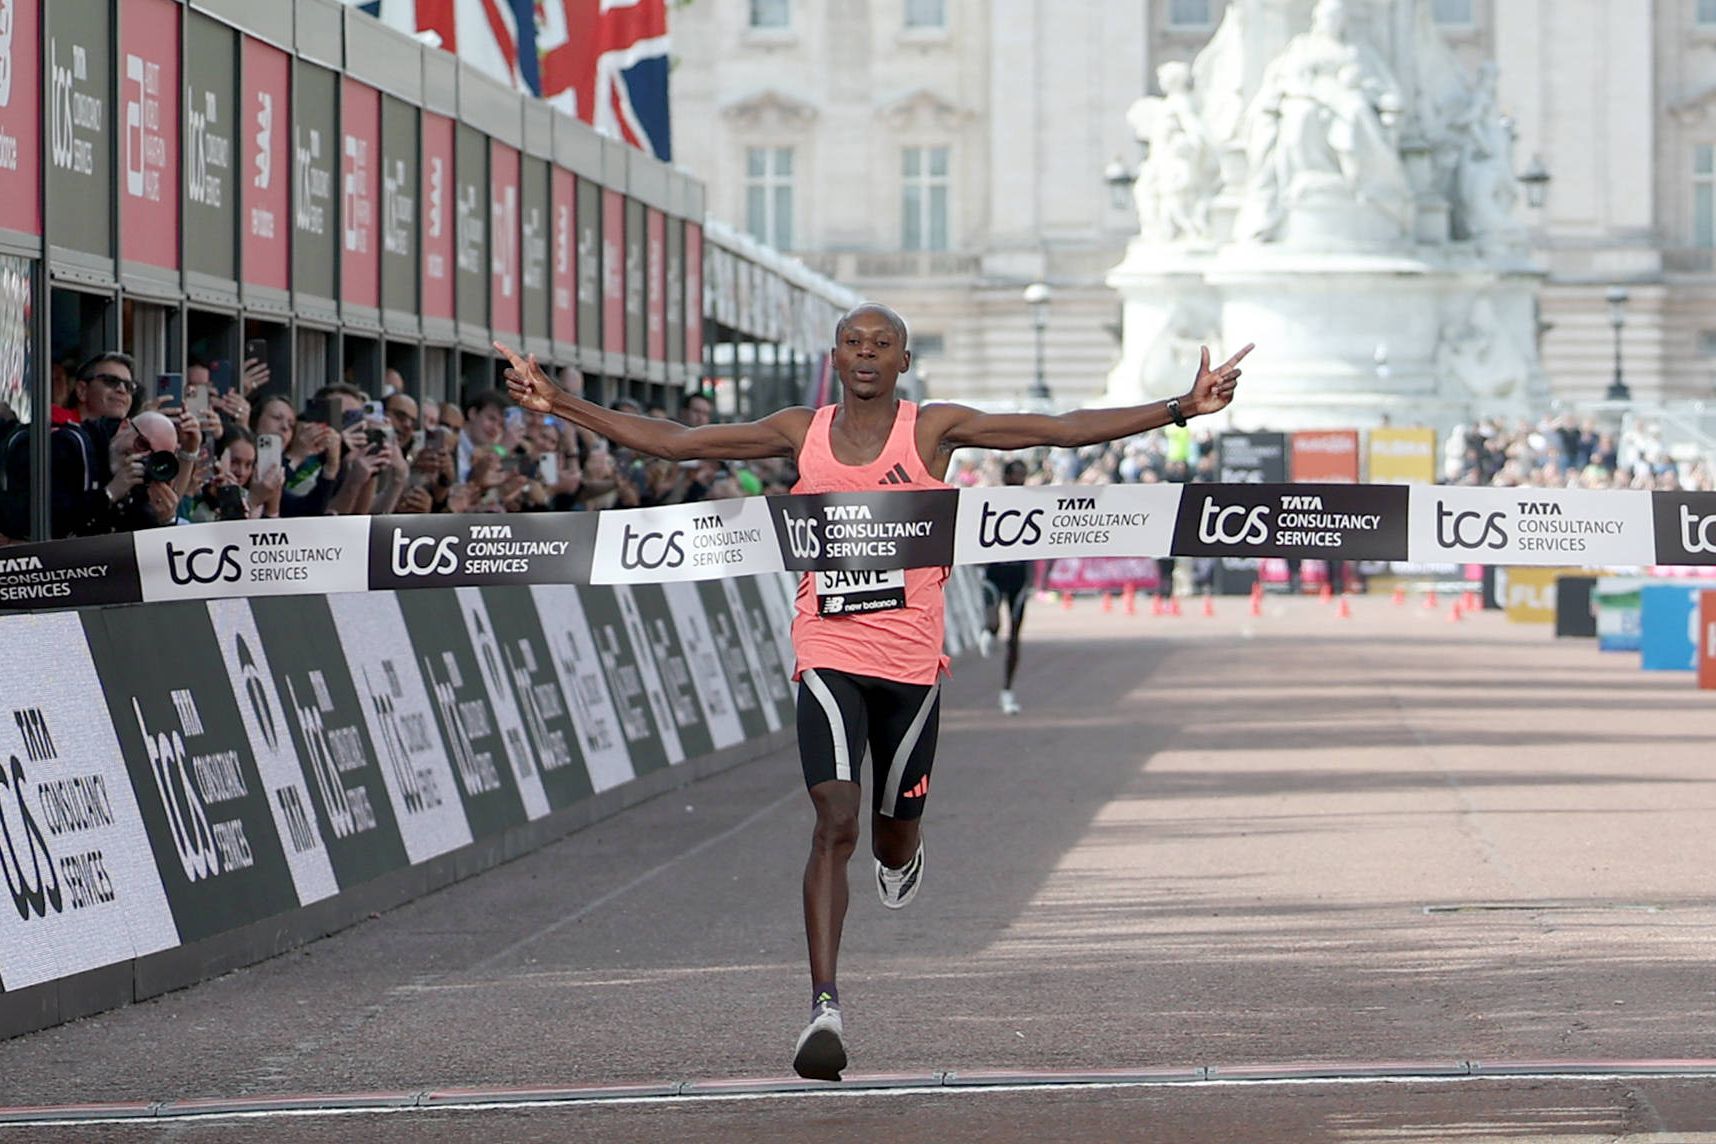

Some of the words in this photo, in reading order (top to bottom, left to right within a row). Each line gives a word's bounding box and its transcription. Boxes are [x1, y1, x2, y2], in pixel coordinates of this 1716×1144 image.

[1056, 498, 1096, 510] TATA
[1280, 496, 1323, 510] TATA
[1517, 503, 1562, 515] TATA
[824, 505, 872, 520] TATA
[1051, 513, 1150, 528] CONSULTANCY
[1198, 496, 1270, 545] tcs
[693, 515, 723, 530] TATA
[825, 521, 933, 539] CONSULTANCY
[979, 501, 1044, 548] tcs
[1277, 513, 1380, 531] CONSULTANCY
[1436, 500, 1508, 550] tcs
[1517, 519, 1624, 535] CONSULTANCY
[249, 533, 288, 546] TATA
[469, 525, 512, 539] TATA
[693, 528, 762, 549] CONSULTANCY
[782, 508, 820, 558] tcs
[1048, 530, 1109, 545] SERVICES
[1275, 531, 1342, 547] SERVICES
[391, 528, 459, 577] tcs
[466, 541, 569, 557] CONSULTANCY
[621, 524, 685, 569] tcs
[826, 541, 897, 558] SERVICES
[1519, 537, 1586, 552] SERVICES
[166, 541, 242, 585] tcs
[250, 547, 342, 565] CONSULTANCY
[693, 549, 744, 567] SERVICES
[0, 565, 108, 585] CONSULTANCY
[251, 567, 308, 582] SERVICES
[465, 558, 529, 574] SERVICES
[823, 570, 889, 588] SAWE
[0, 583, 71, 600] SERVICES
[844, 602, 862, 612] new
[862, 599, 897, 610] balance
[170, 689, 204, 737] TATA
[13, 707, 58, 762] TATA
[132, 697, 219, 882] tcs
[38, 774, 115, 836] CONSULTANCY
[60, 851, 115, 910] SERVICES
